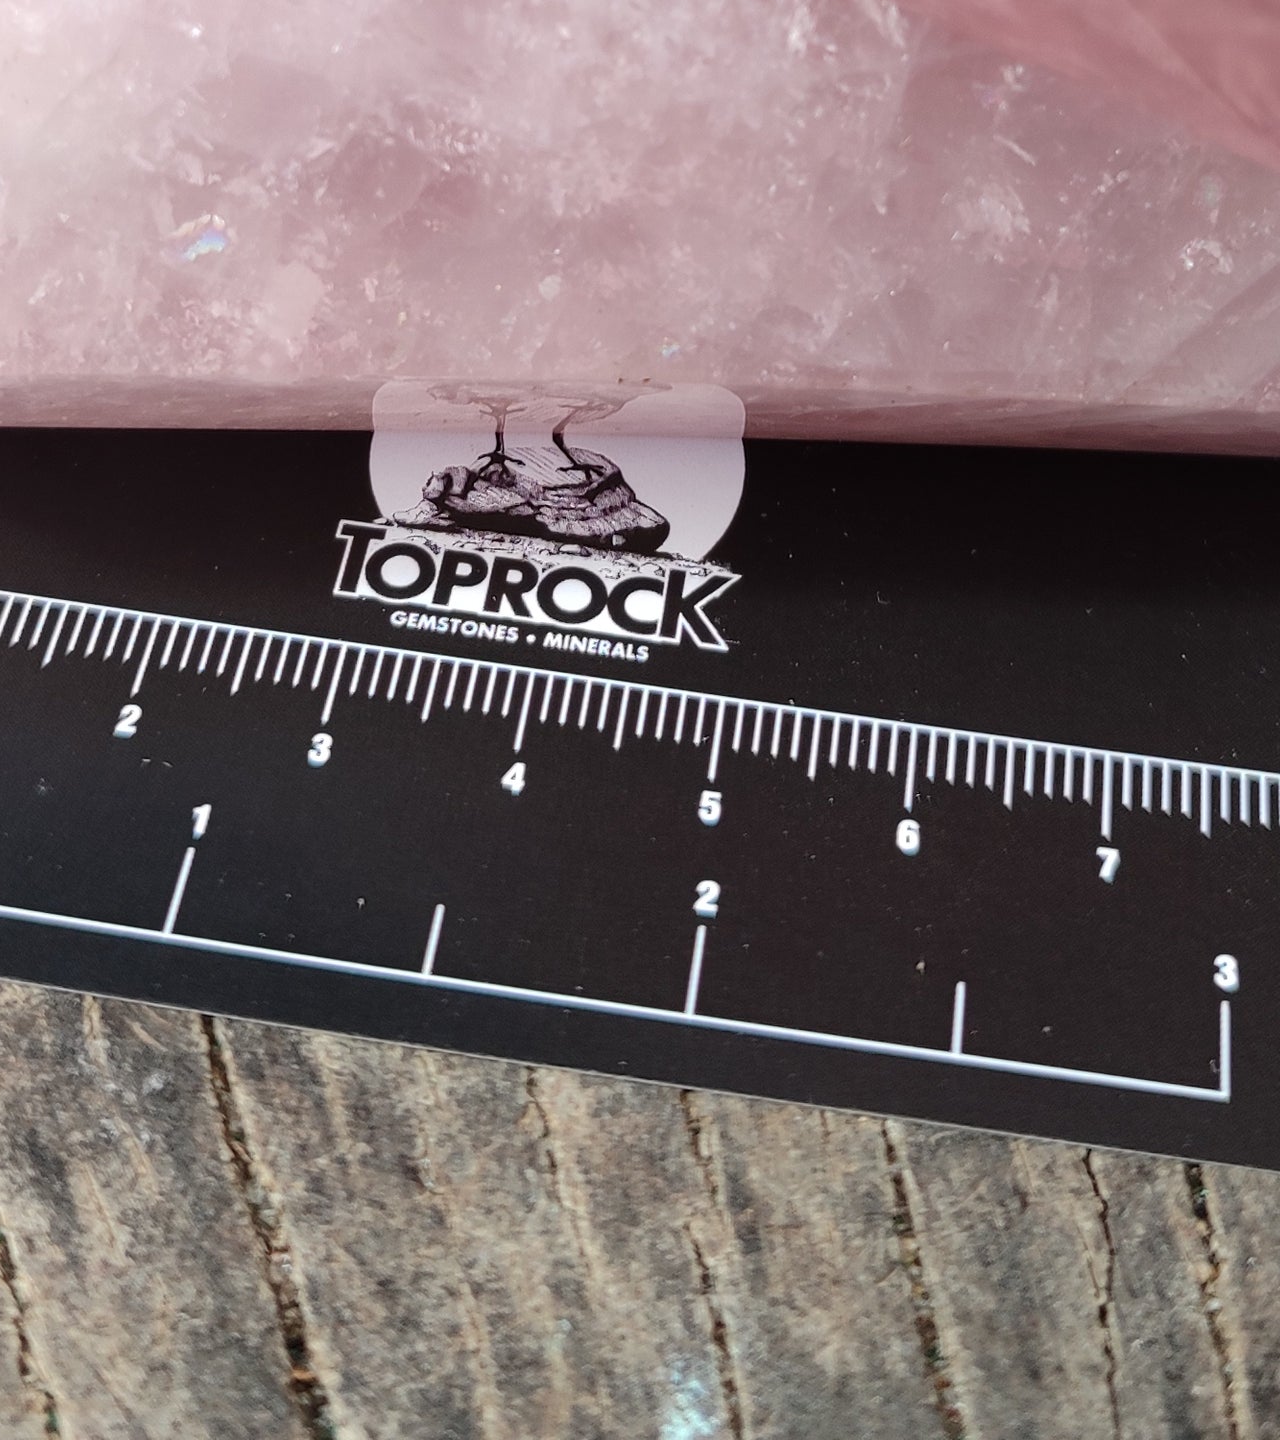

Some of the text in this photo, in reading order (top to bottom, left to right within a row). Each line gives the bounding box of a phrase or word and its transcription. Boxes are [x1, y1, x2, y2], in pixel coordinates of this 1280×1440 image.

[335, 521, 740, 650] TOPROCK
[388, 609, 651, 663] GEMSTONES MINERALS
[112, 703, 144, 739] 2
[306, 731, 334, 767] 3
[499, 760, 527, 796] 4
[696, 788, 724, 826] 5
[894, 818, 922, 856] 6
[1094, 845, 1122, 884] 7
[190, 802, 214, 840] 1
[691, 878, 722, 917] 2
[1211, 952, 1240, 993] 3
